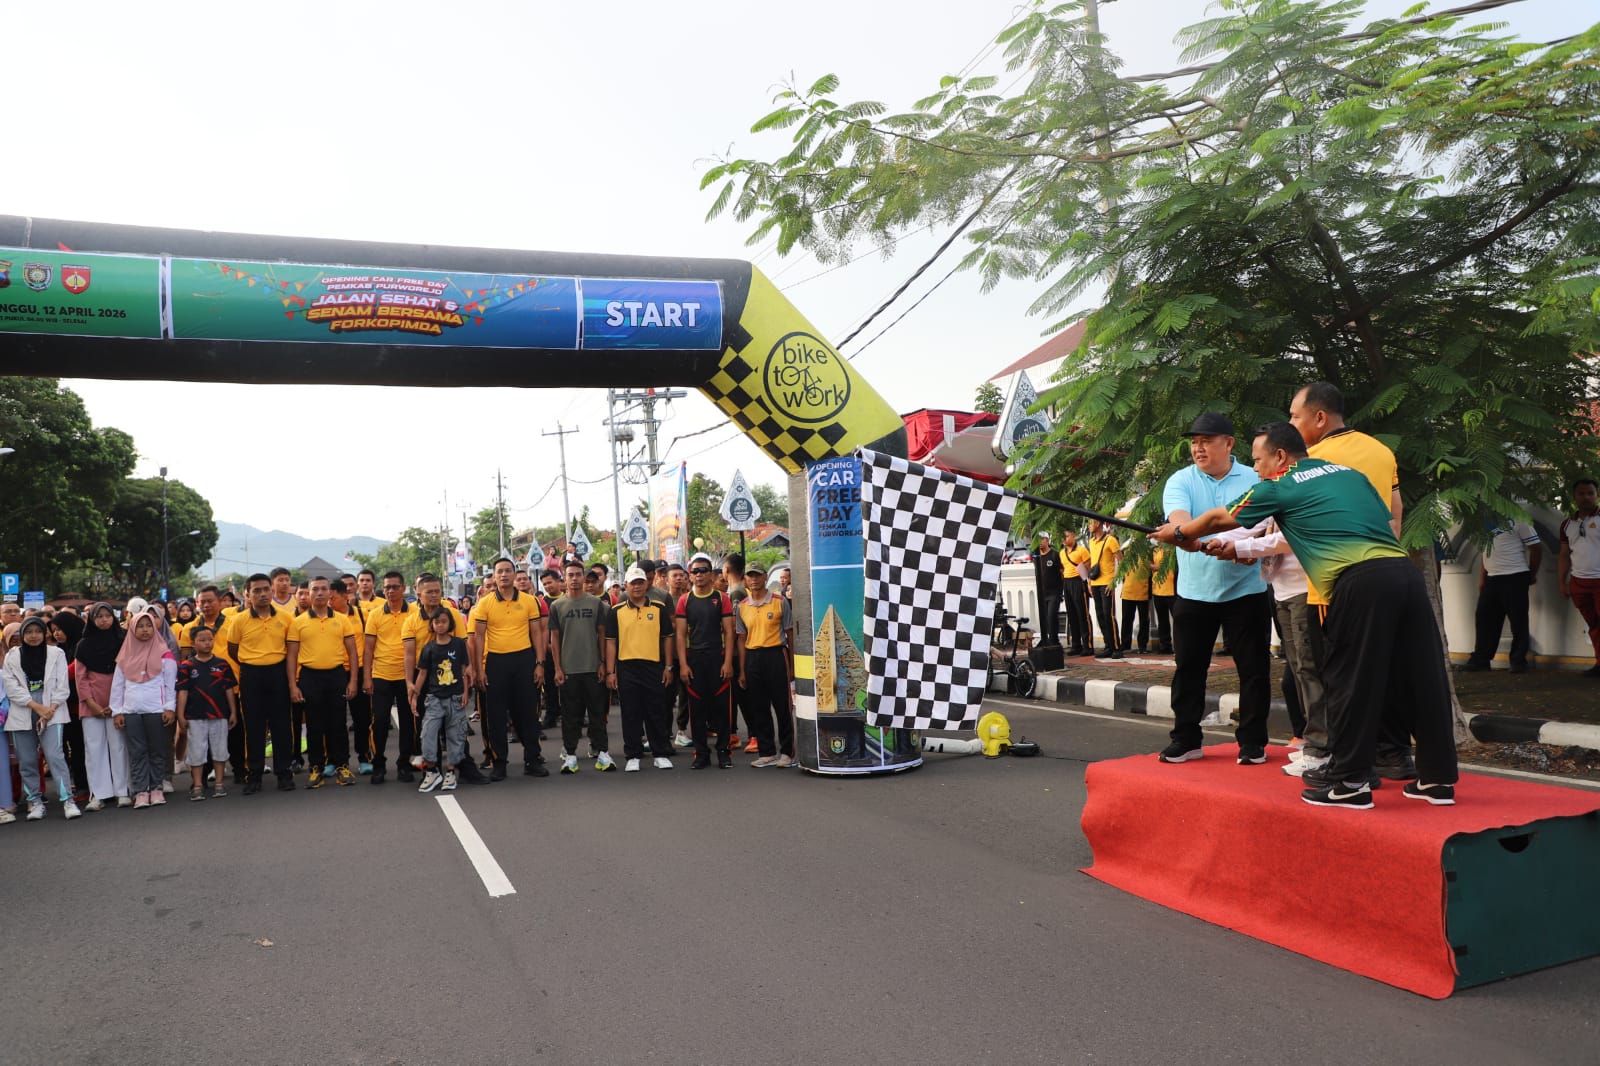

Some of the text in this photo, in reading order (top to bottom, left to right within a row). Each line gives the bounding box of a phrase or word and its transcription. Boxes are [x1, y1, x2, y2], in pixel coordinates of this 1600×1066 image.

[322, 276, 369, 284] OPENING
[427, 281, 448, 289] DAY
[327, 283, 443, 295] PEMKAB PURWOREJO
[312, 294, 458, 311] JALAN SEHAT &
[43, 306, 56, 315] 12
[58, 306, 95, 317] APRIL
[98, 308, 126, 318] 2026
[307, 306, 463, 325] SENAM BERSAMA
[606, 301, 701, 327] START
[330, 318, 442, 334] FORKOPIMDA
[783, 340, 828, 365] bike
[773, 365, 801, 386] to
[783, 383, 845, 407] work
[816, 462, 853, 470] OPENING
[817, 470, 854, 487] CAR
[817, 488, 861, 504] FREE
[817, 505, 854, 522] DAY
[4, 576, 16, 591] P
[565, 608, 592, 618] 412
